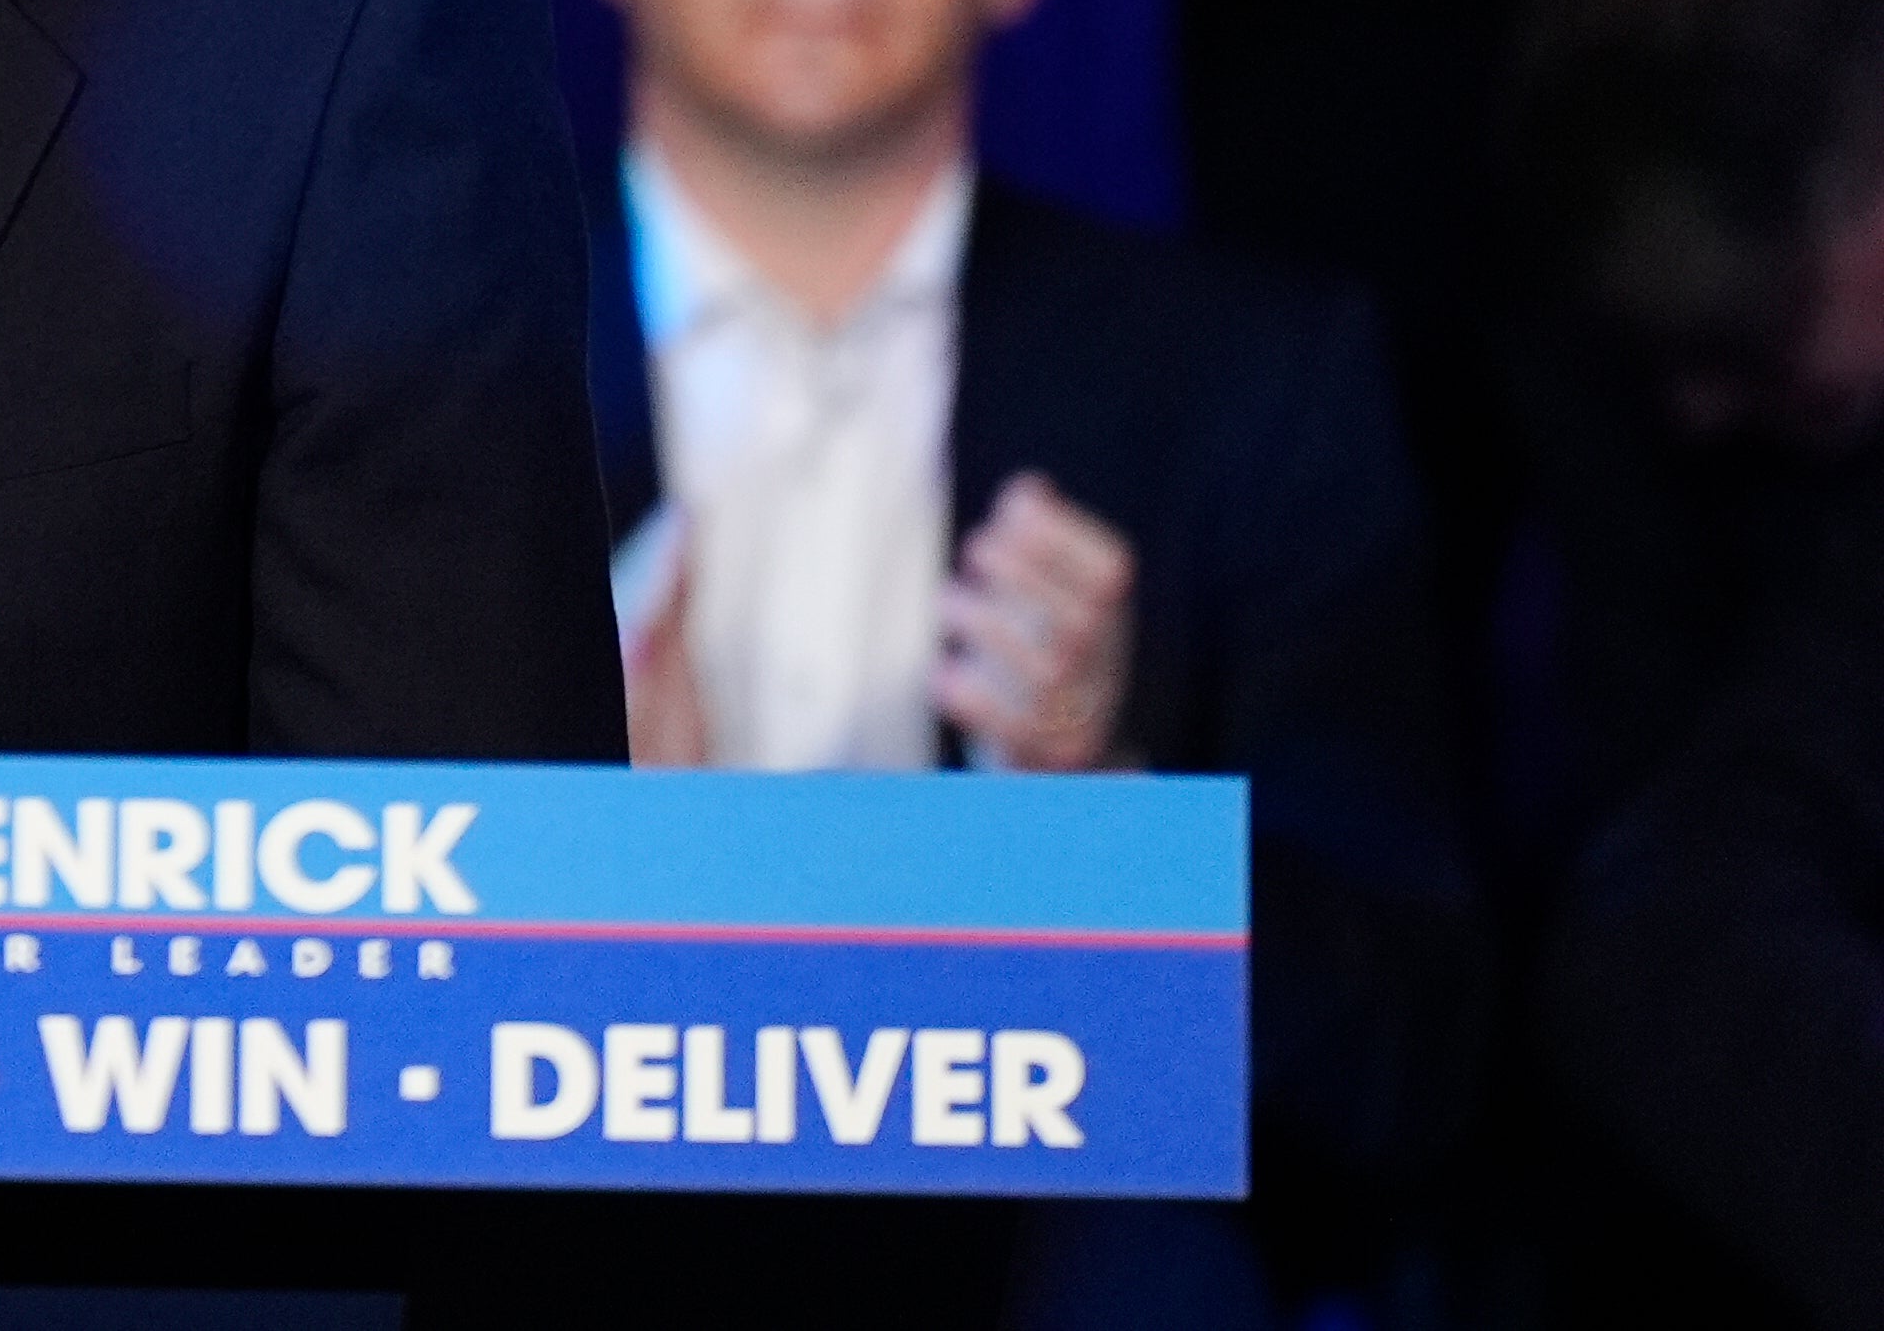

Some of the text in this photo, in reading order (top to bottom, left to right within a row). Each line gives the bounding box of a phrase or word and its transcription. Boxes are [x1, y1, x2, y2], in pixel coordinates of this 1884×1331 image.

[111, 935, 454, 980] LEADER
[38, 1014, 348, 1137] WIN
[490, 1021, 1086, 1149] DELIVER
